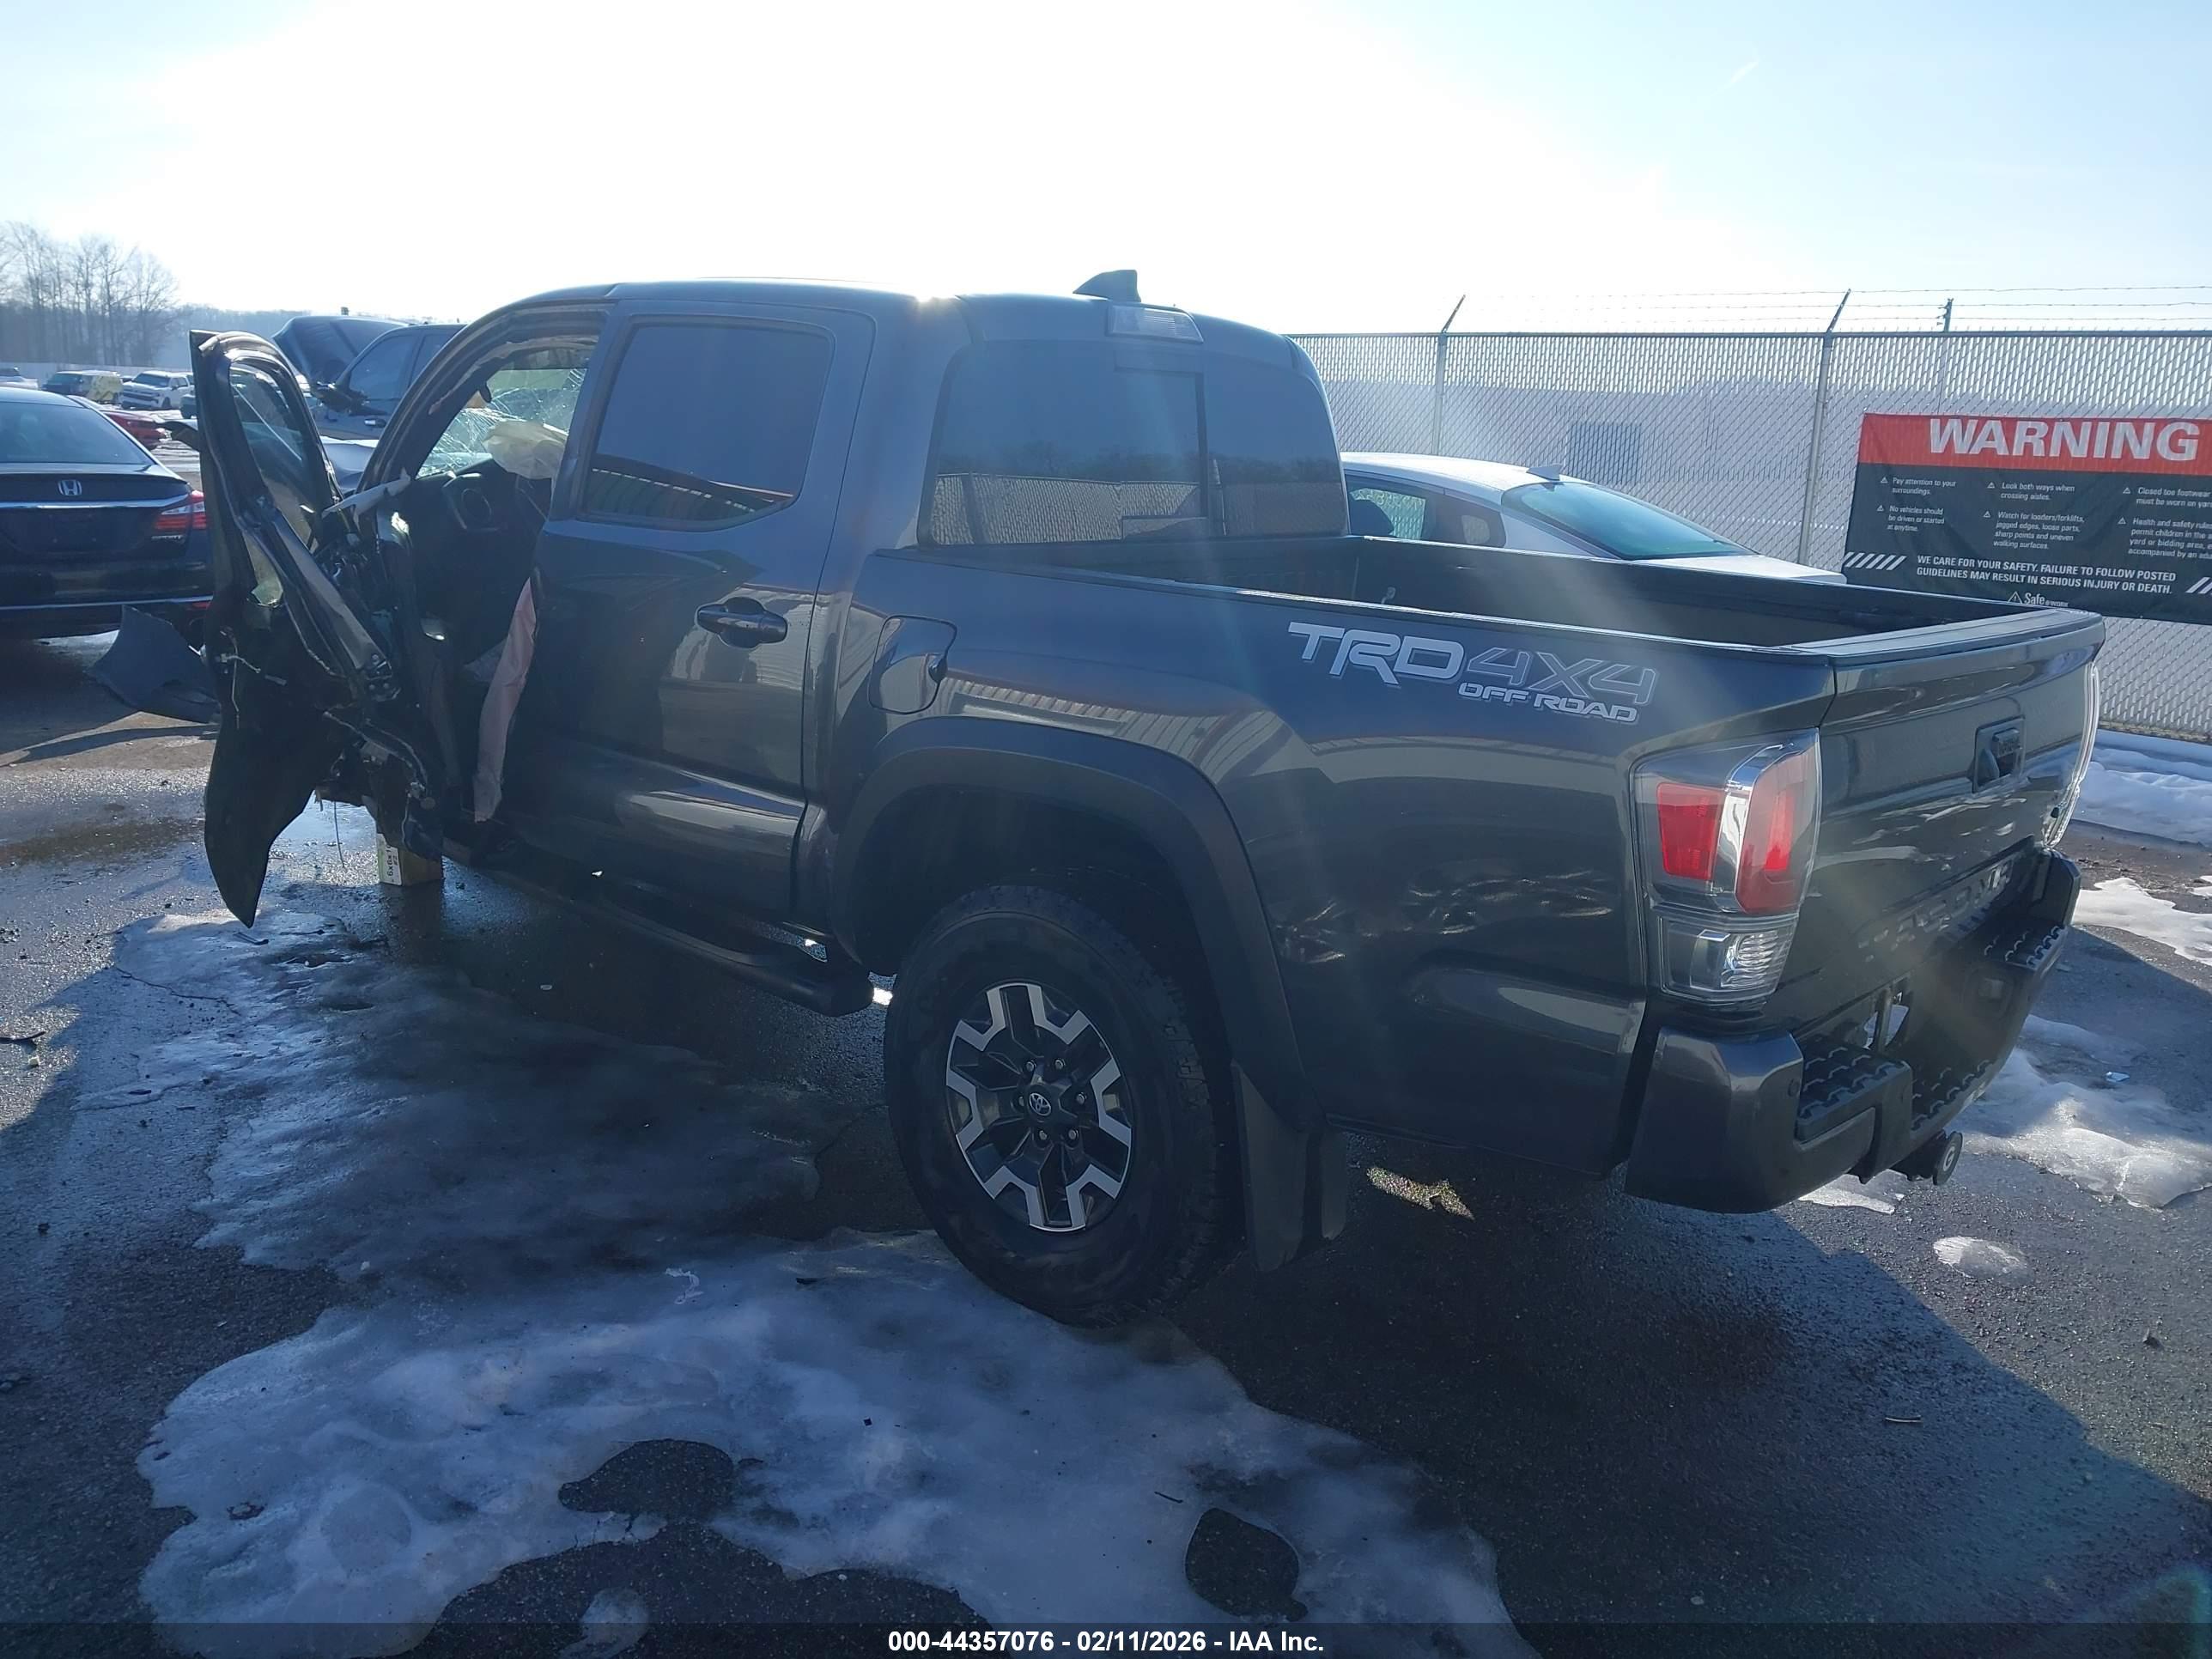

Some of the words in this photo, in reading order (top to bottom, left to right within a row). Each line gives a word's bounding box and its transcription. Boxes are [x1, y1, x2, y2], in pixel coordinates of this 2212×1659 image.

[1929, 418, 2200, 461] WARNING
[2001, 492, 2028, 501] crossing
[2137, 487, 2162, 495] Closed
[2177, 489, 2211, 497] footwear
[1996, 520, 2018, 529] jagged
[2020, 522, 2040, 531] edges,
[2172, 520, 2195, 529] safety
[1995, 530, 2013, 538] sharp
[1993, 540, 2018, 549] walking
[2158, 539, 2185, 549] bidding
[2128, 548, 2175, 556] accompanied
[1917, 555, 1931, 564] WE
[1934, 556, 1956, 566] CARE
[1958, 558, 1975, 568] FOR
[1977, 560, 2002, 569] YOUR
[2002, 562, 2038, 573] SAFETY.
[2040, 563, 2078, 575] FAILURE
[2081, 566, 2093, 576] TO
[2095, 567, 2136, 579] FOLLOW
[2136, 570, 2177, 581] POSTED
[1917, 568, 1968, 580] GUIDELINES
[1970, 571, 1990, 580] MAY
[1992, 573, 2026, 583] RESULT
[2027, 574, 2038, 584] IN
[2039, 575, 2081, 587] SERIOUS
[2083, 580, 2120, 590] INJURY
[2122, 581, 2135, 591] OR
[2136, 583, 2172, 594] DEATH.
[1288, 622, 1465, 685] TRD
[1465, 647, 1658, 705] 4X4
[1457, 682, 1530, 704] OFF
[1533, 694, 1638, 723] ROAD
[1943, 1146, 1955, 1171] G
